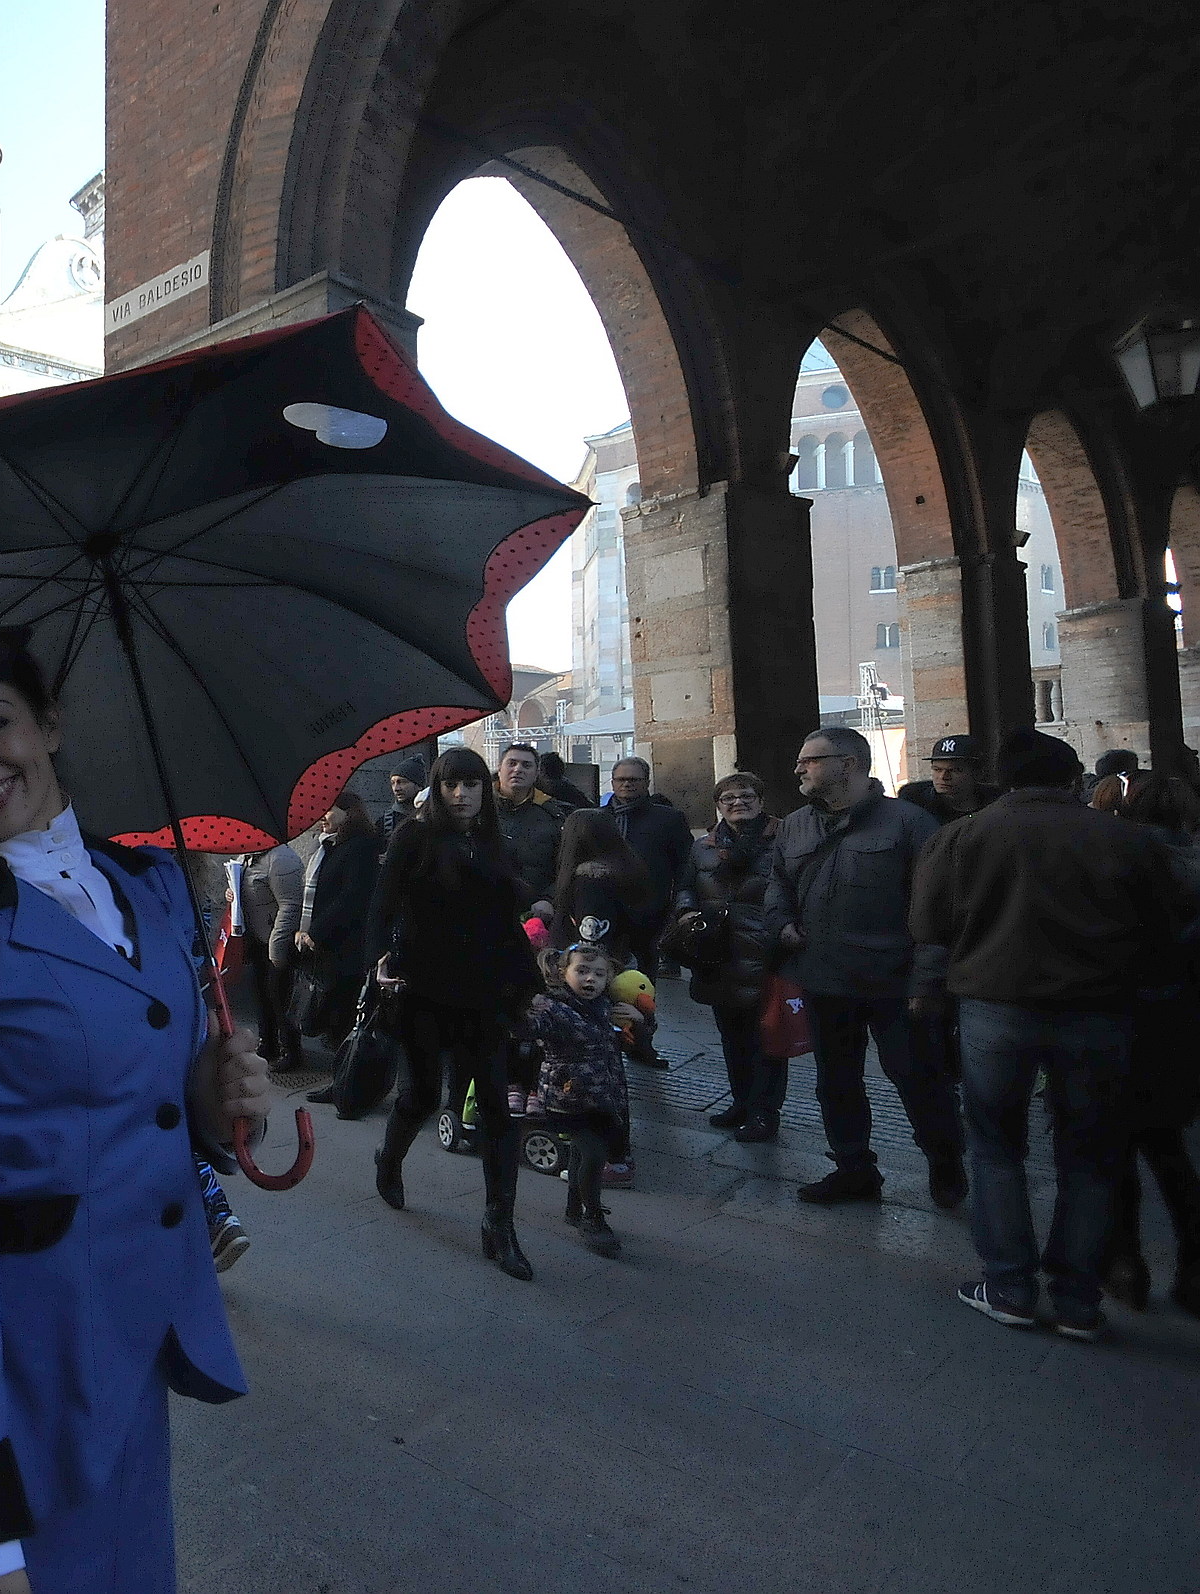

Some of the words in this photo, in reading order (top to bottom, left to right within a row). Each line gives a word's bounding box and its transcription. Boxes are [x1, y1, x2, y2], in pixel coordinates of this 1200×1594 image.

[112, 301, 131, 322] VIA
[139, 264, 202, 309] BALDESIO
[941, 739, 956, 752] NY
